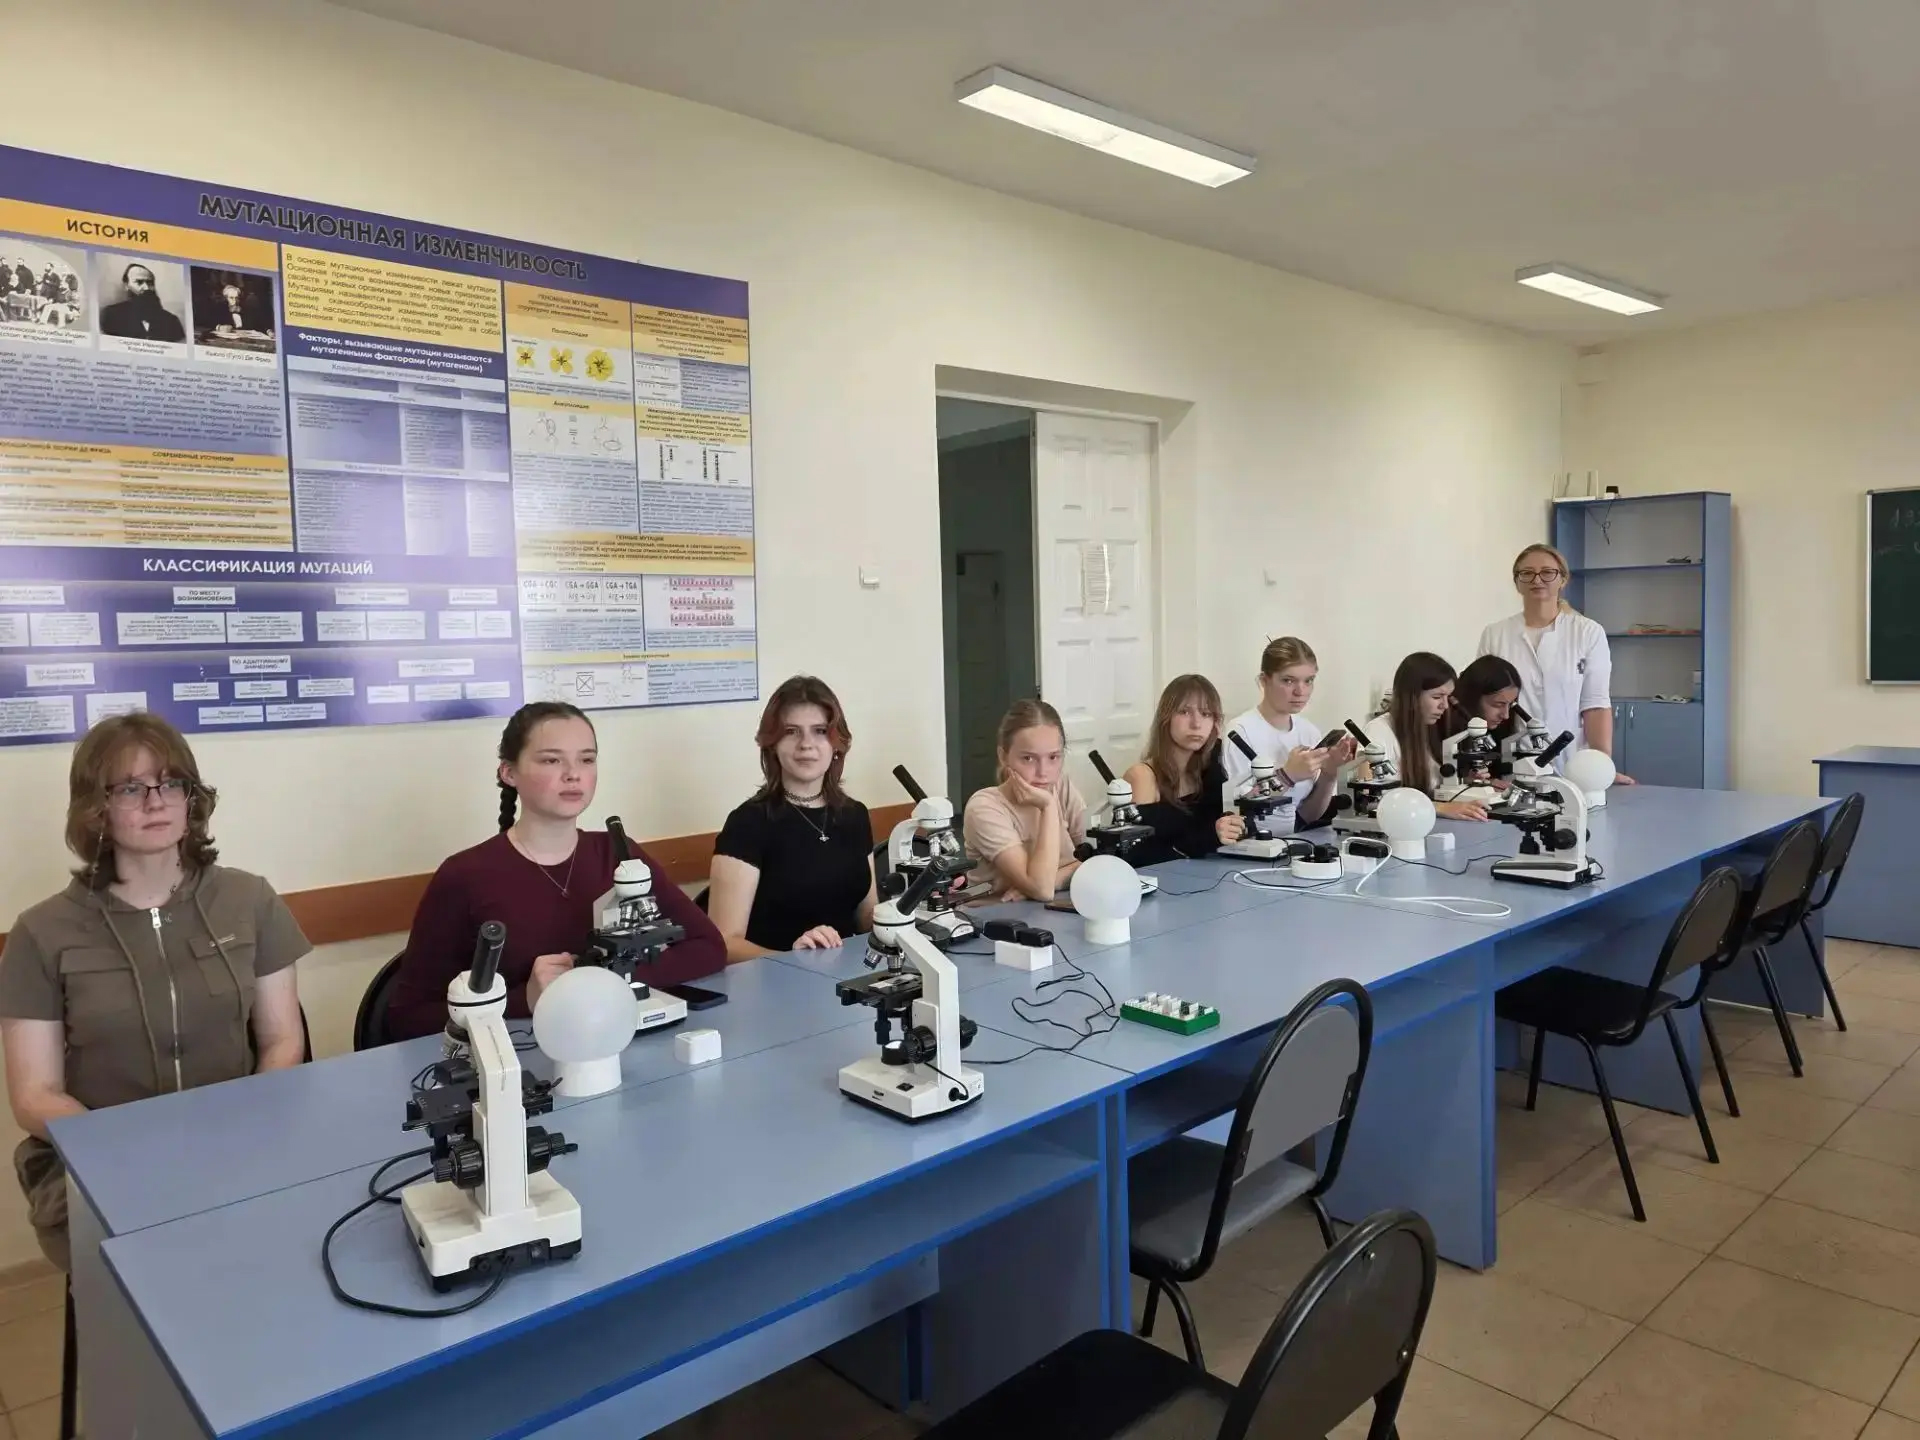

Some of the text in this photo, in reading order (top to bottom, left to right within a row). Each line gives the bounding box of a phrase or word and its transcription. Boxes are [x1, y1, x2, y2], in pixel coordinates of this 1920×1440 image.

[67, 218, 149, 244] ИСТОРИЯ
[198, 192, 588, 281] МУТАЦИОННАЯ ИЗМЕНЧИВОСТЬ
[296, 256, 326, 266] основе
[288, 282, 334, 295] Мутациями
[298, 332, 492, 364] Факторы, вызывающие мутации называются
[310, 346, 484, 374] мутагенными факторами (мутагенами)
[143, 558, 374, 576] КЛАССИФИКАЦИЯ МУТАЦИЙ
